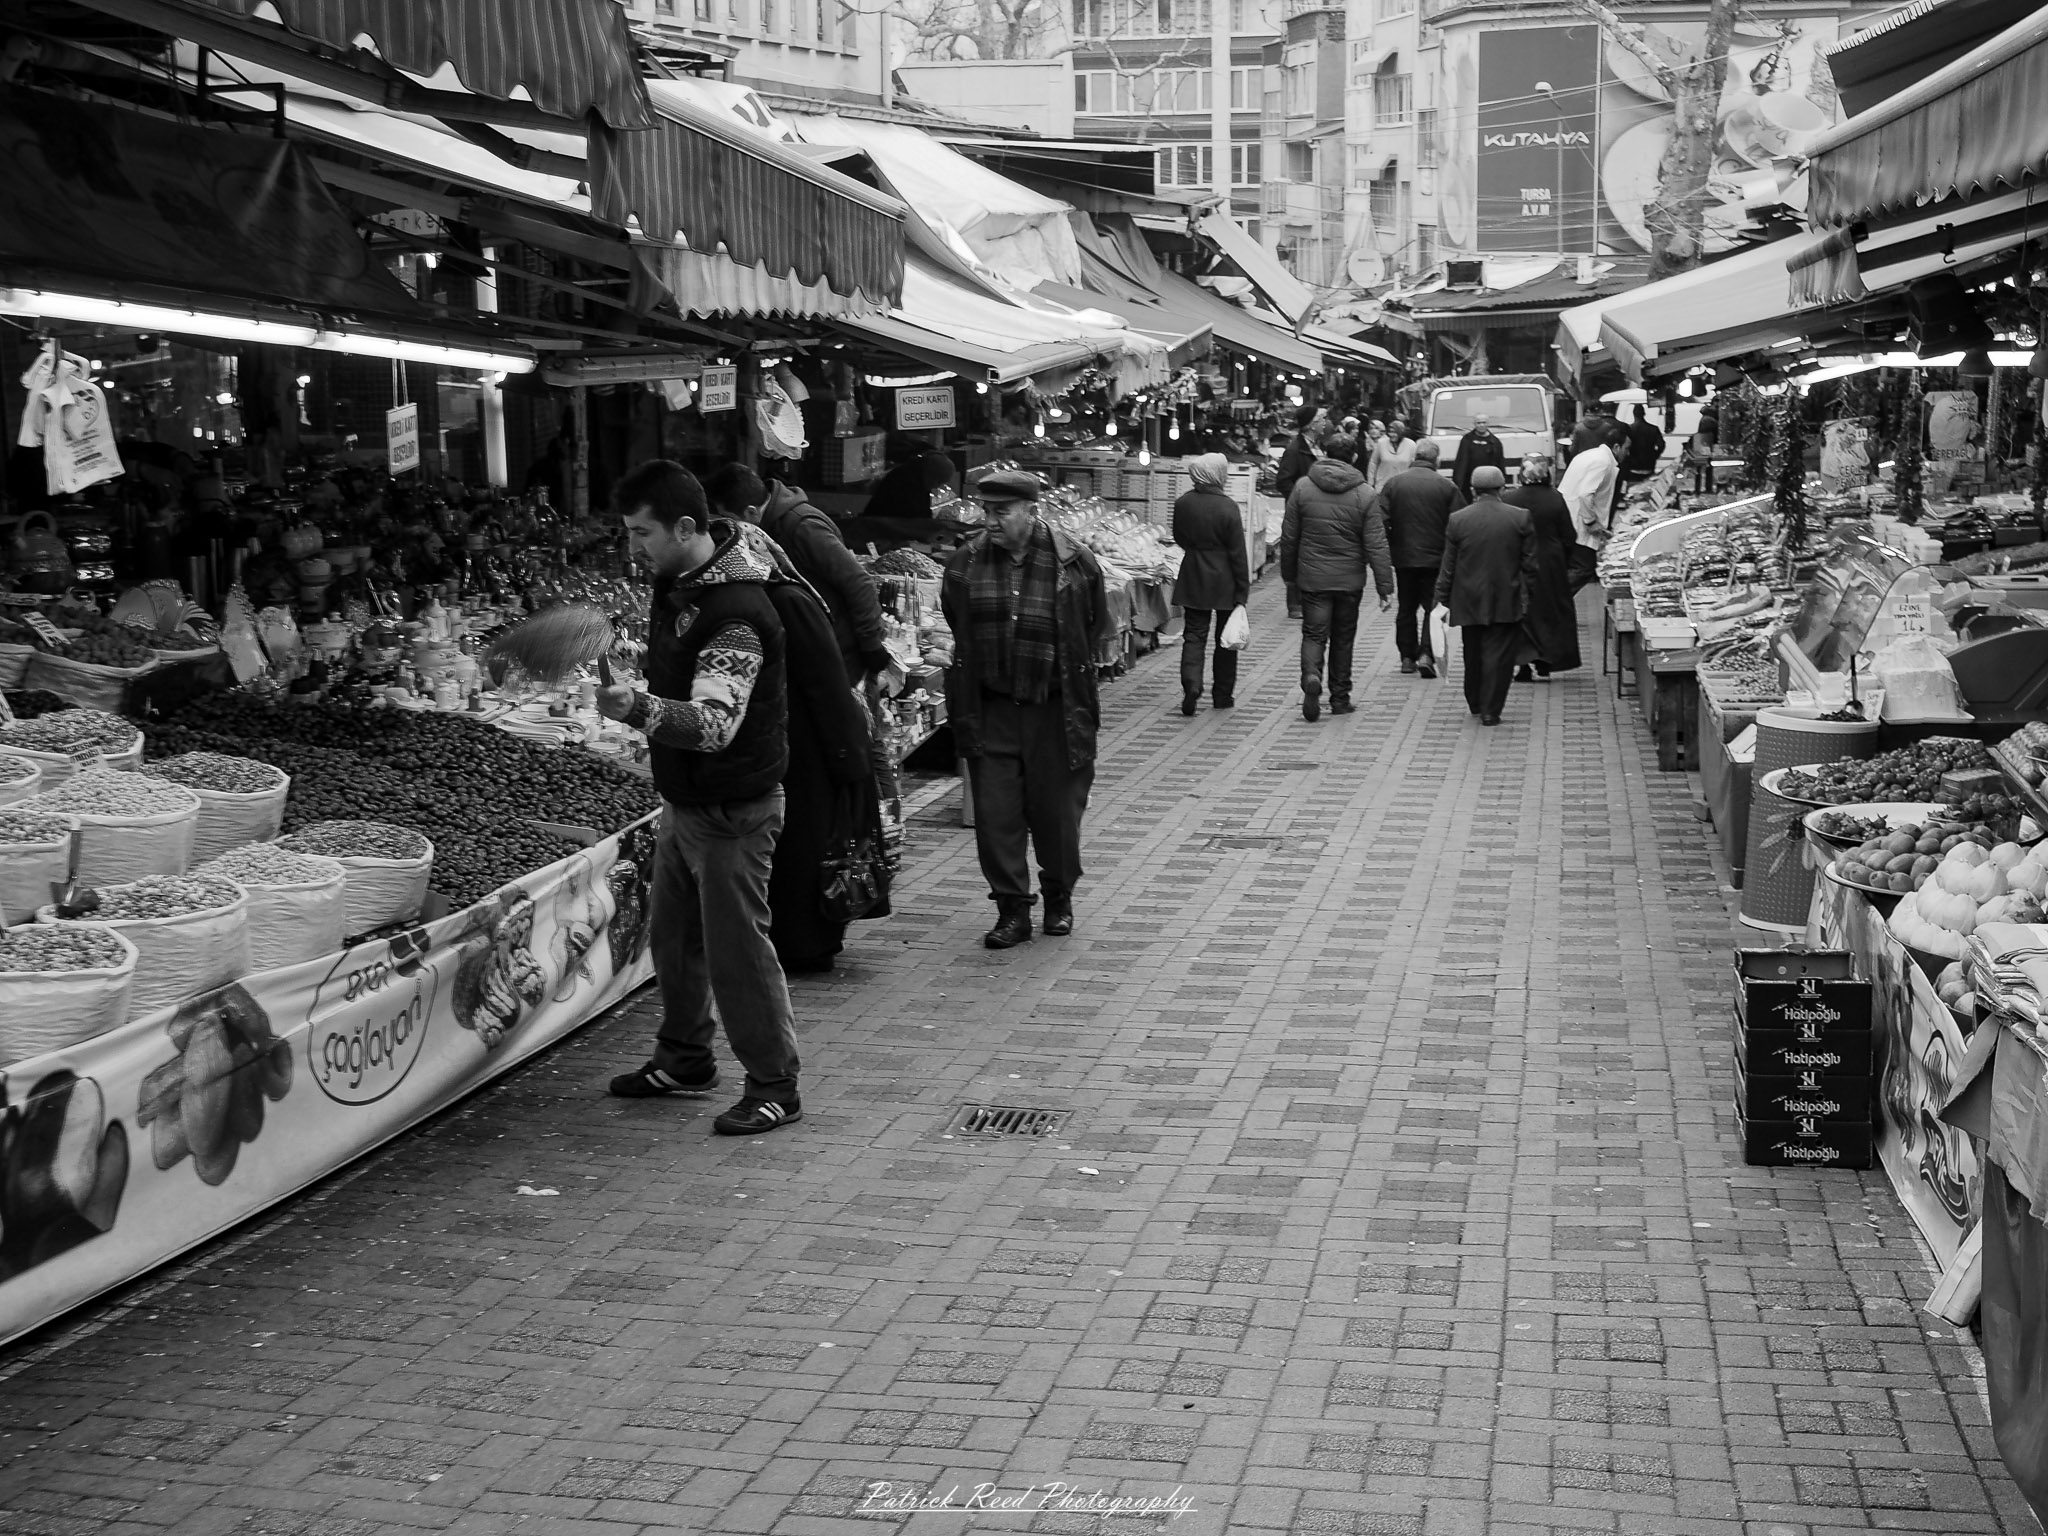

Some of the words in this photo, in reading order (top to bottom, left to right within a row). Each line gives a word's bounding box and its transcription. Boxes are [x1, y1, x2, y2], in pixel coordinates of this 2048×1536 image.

[1520, 188, 1551, 201] TURSA
[902, 395, 924, 405] KREDİ
[926, 394, 949, 404] KARTI
[904, 409, 949, 423] GEÇERLİDİR
